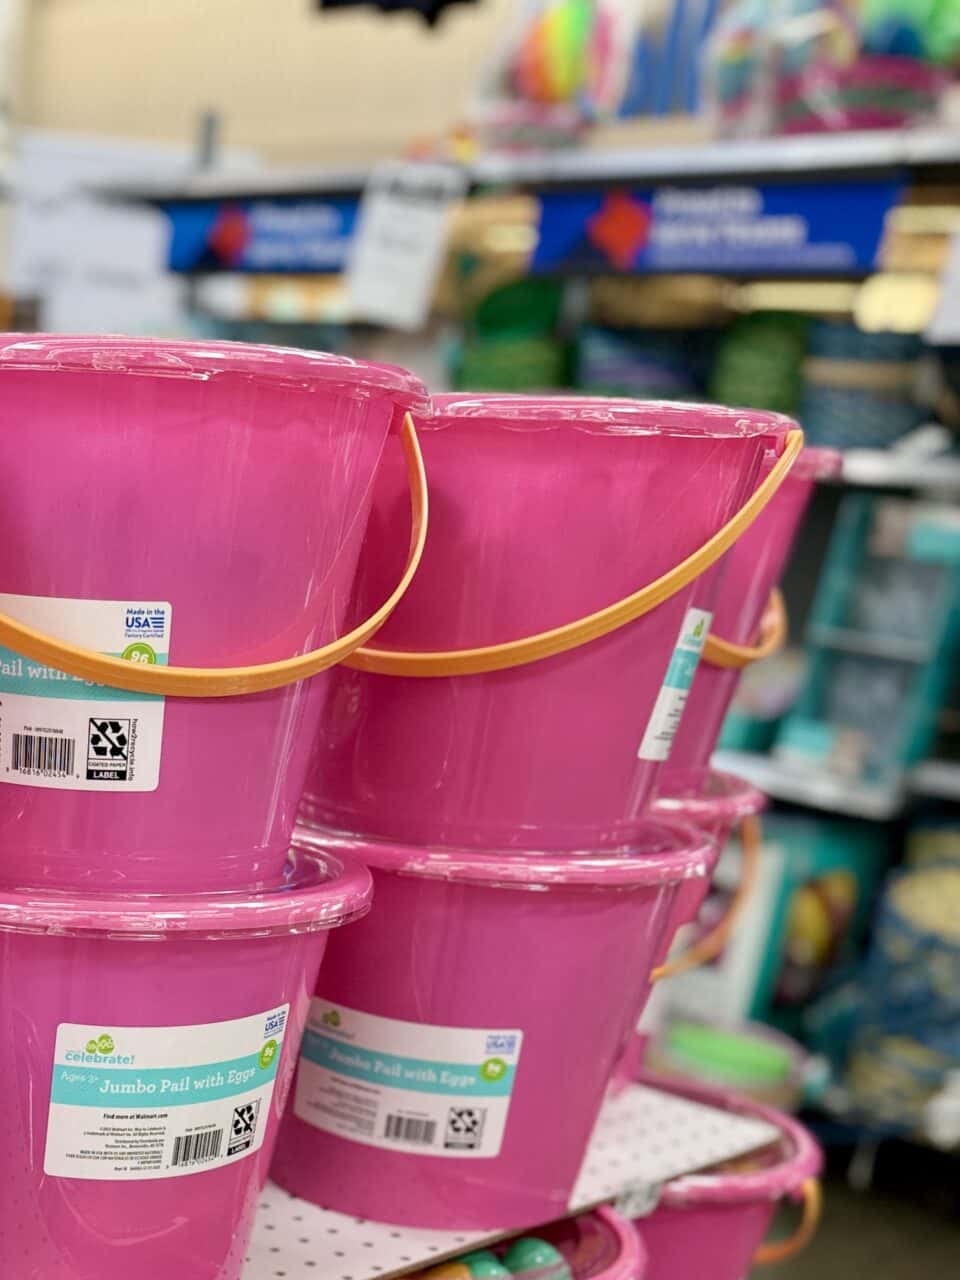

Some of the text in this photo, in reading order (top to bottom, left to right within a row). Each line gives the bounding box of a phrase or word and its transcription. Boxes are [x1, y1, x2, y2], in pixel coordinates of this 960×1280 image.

[126, 616, 150, 628] USA
[93, 771, 120, 779] LABEL
[64, 1052, 136, 1065] celebrate!
[99, 1067, 257, 1094] Jumbo Pail with Eggs
[403, 1063, 436, 1084] with
[439, 1072, 477, 1089] Eggs
